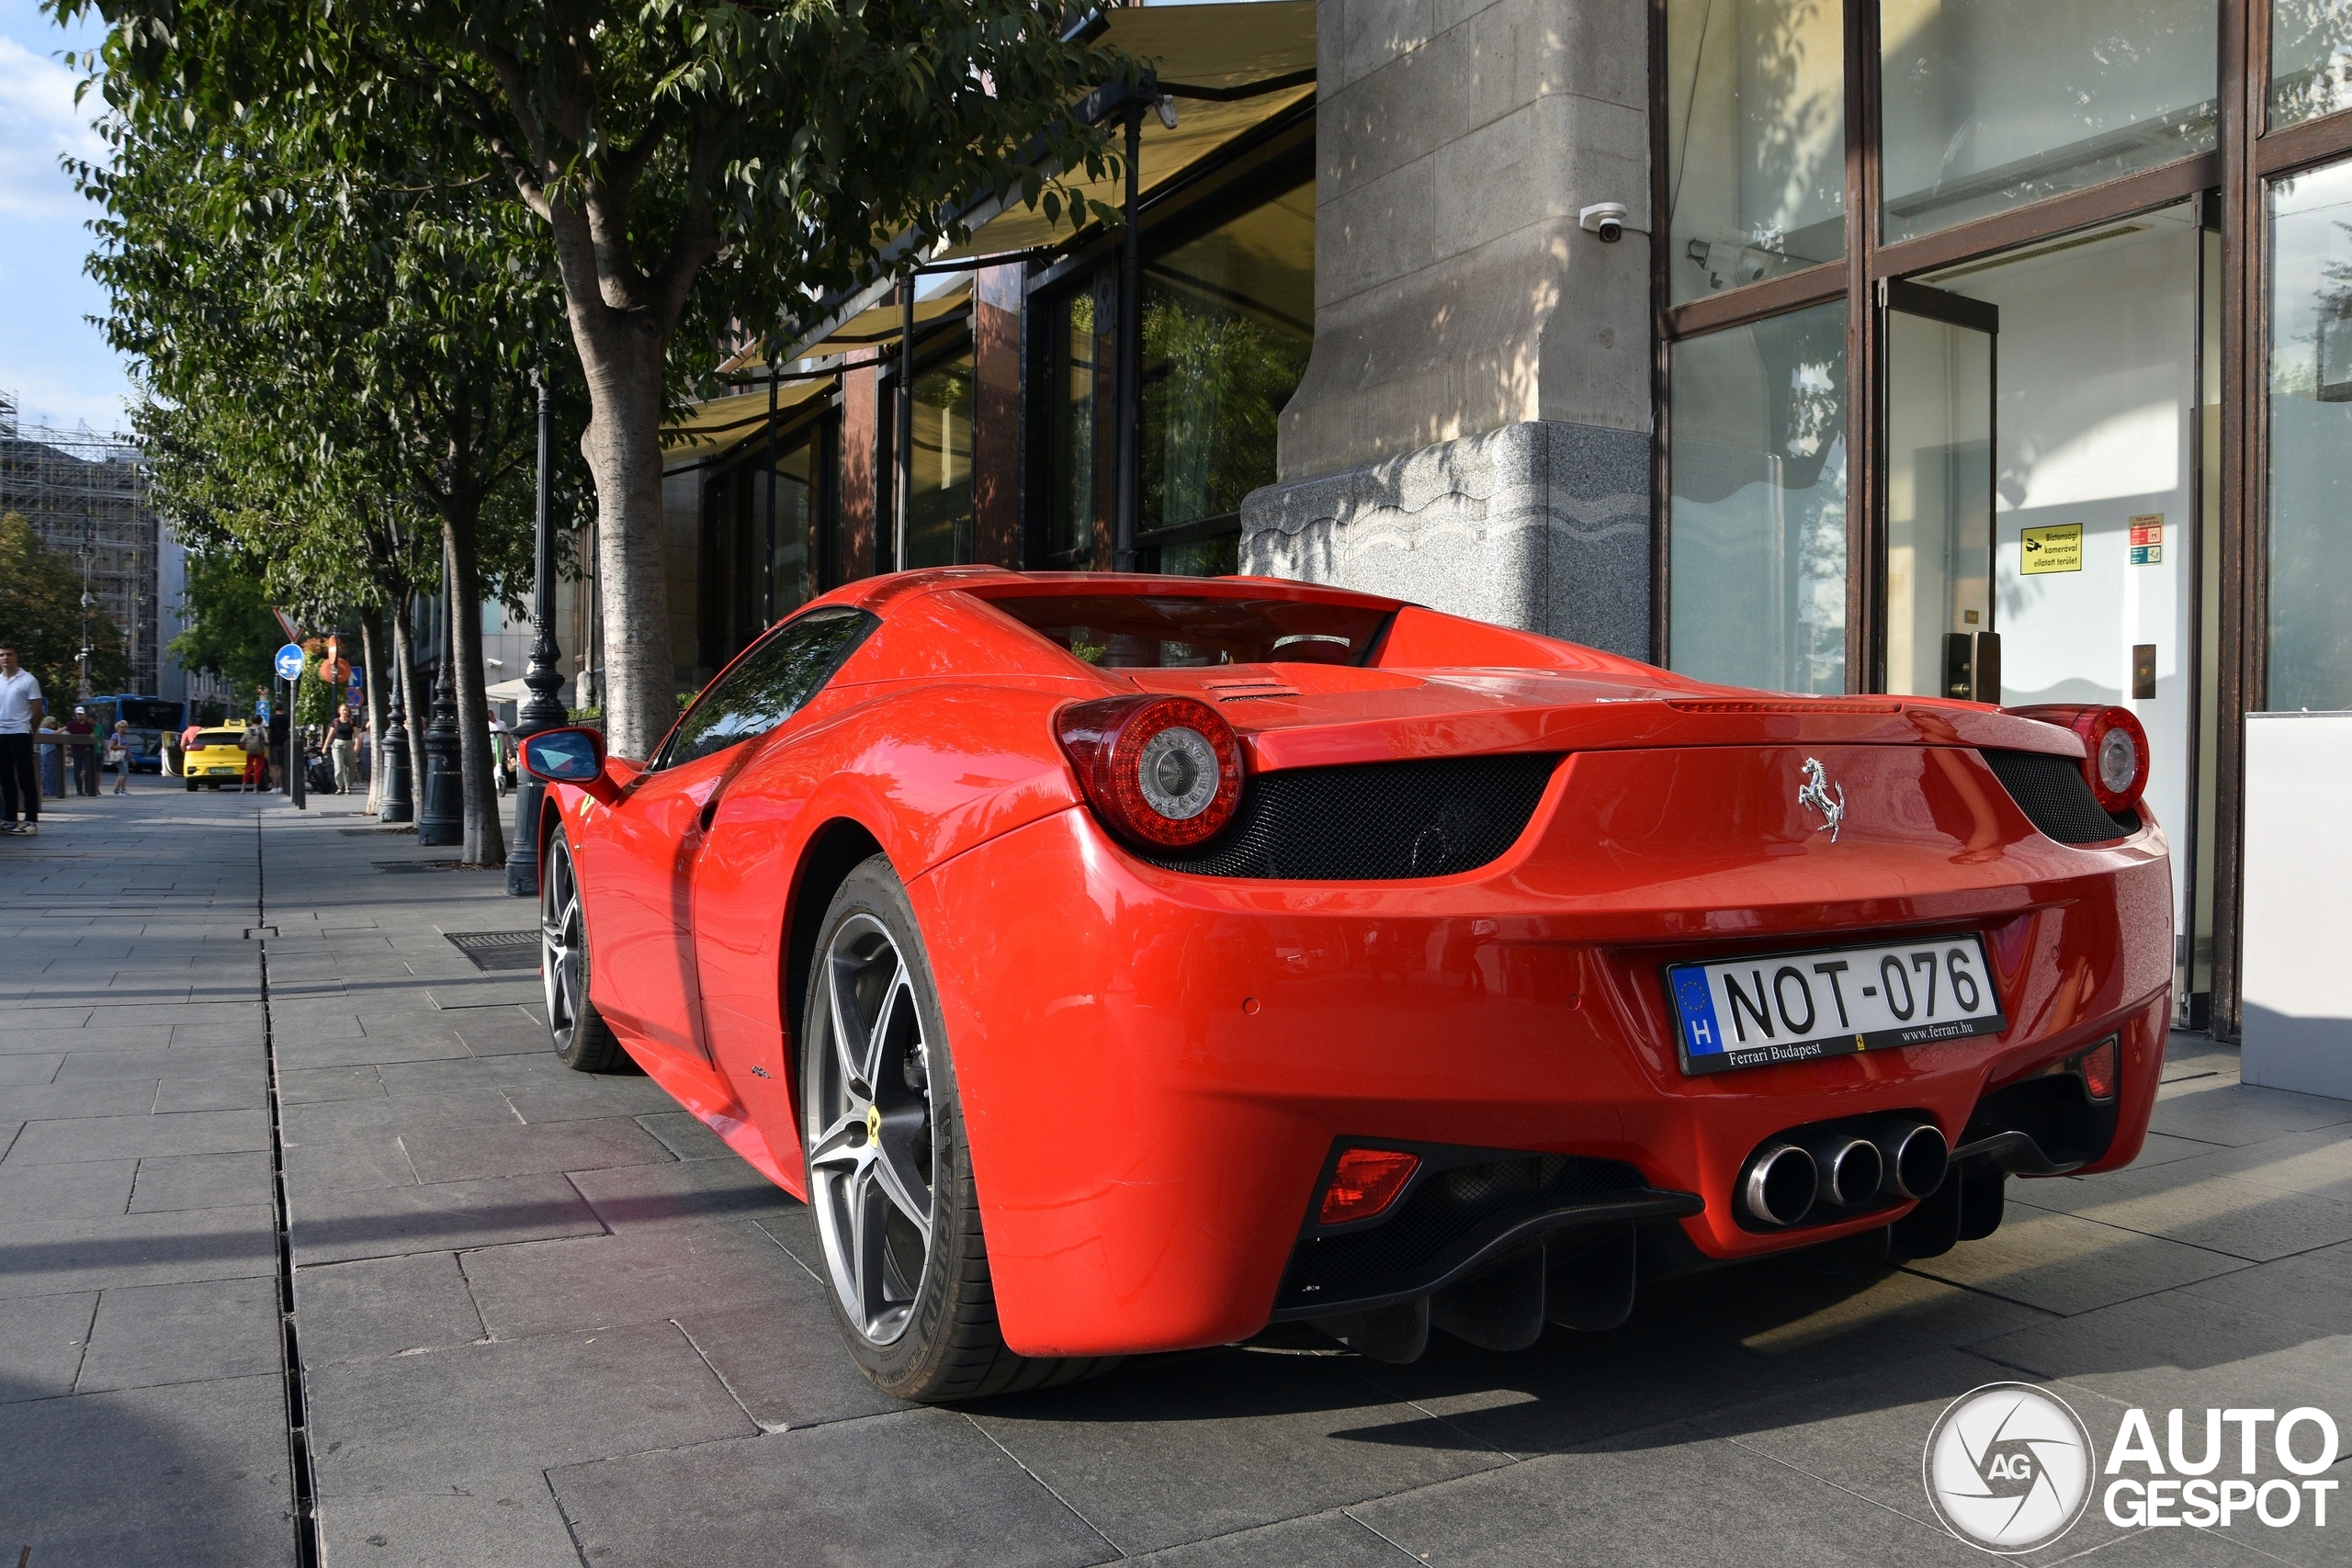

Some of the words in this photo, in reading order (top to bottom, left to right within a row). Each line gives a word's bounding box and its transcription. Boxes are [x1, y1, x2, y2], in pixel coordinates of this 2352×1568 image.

[2045, 530, 2078, 542] Biztonsági
[2044, 543, 2077, 554] kamerával
[2033, 558, 2055, 567] ellátott
[2057, 556, 2077, 566] terület
[1723, 948, 1980, 1042] NOT-076
[1691, 1020, 1712, 1044] H
[1902, 1021, 1973, 1042] www.ferrari.hu
[1728, 1047, 1769, 1066] Ferrari
[1770, 1043, 1822, 1060] Budapest
[921, 1161, 953, 1337] MICHELIN
